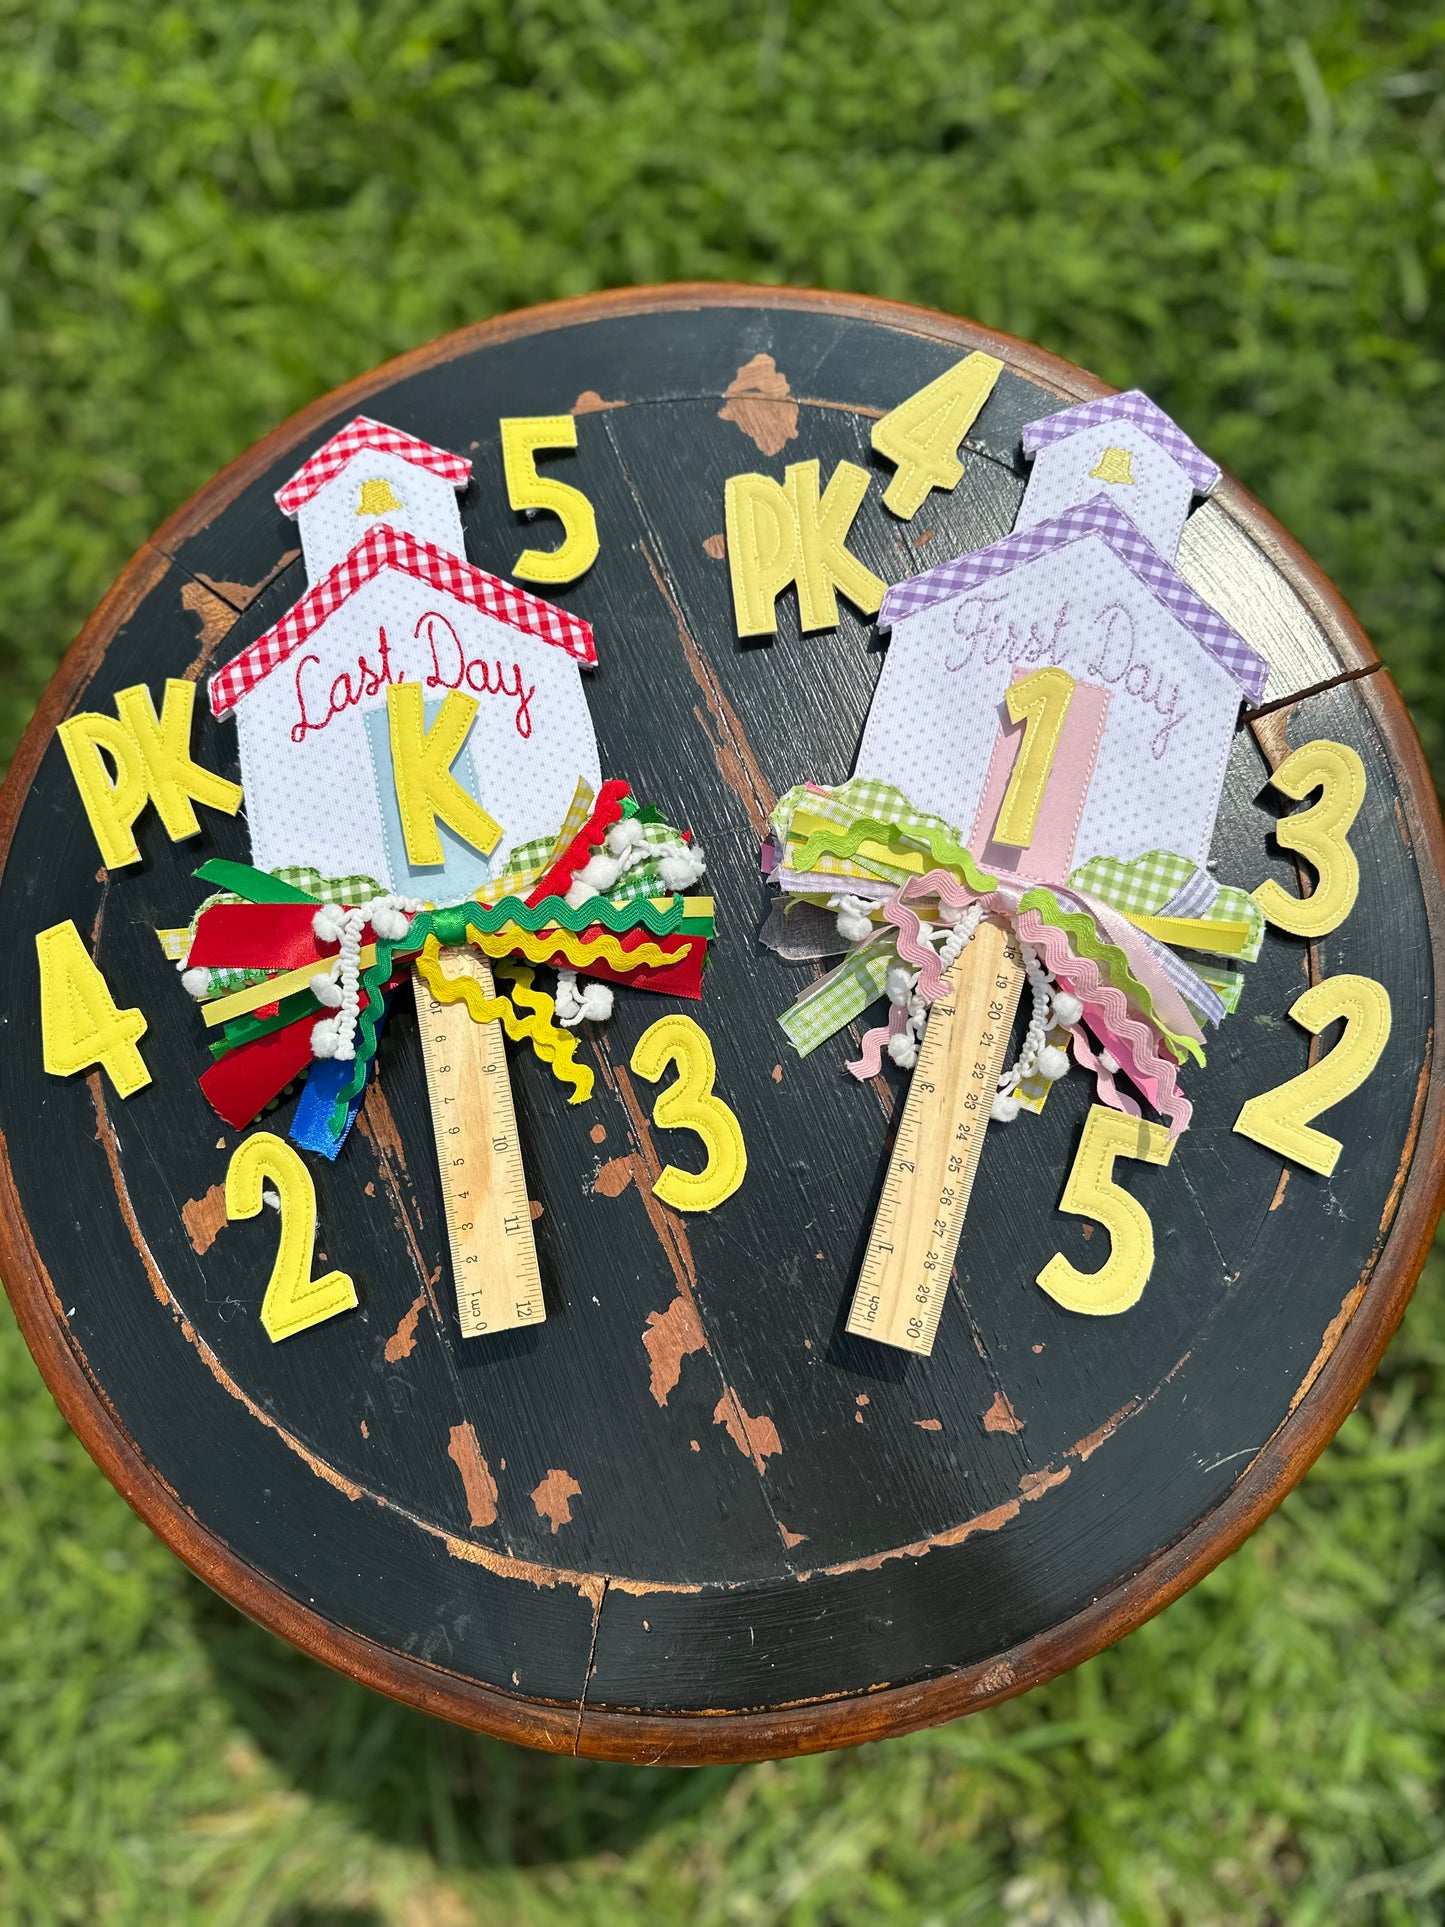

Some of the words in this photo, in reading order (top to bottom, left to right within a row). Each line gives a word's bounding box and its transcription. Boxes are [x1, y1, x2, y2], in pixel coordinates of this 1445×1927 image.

[871, 351, 1005, 521] 4
[500, 414, 600, 584] 5
[724, 459, 890, 638] PK
[291, 626, 406, 743] Last
[414, 611, 535, 739] Day
[944, 594, 1067, 672] First
[1088, 602, 1185, 759] Day
[992, 666, 1077, 850] 1
[58, 678, 244, 870] PK
[386, 681, 504, 867] K
[1253, 739, 1367, 938] 3
[1003, 946, 1016, 960] 18
[995, 974, 1009, 988] 19
[35, 919, 153, 1099] 4
[430, 1001, 443, 1015] 10
[941, 1007, 956, 1016] 4
[987, 1002, 1004, 1020] 20
[435, 1035, 447, 1043] 9
[979, 1031, 994, 1048] 21
[440, 1065, 451, 1073] 8
[972, 1062, 986, 1080] 22
[1232, 974, 1393, 1177] 2
[920, 1084, 935, 1094] 3
[444, 1097, 455, 1105] 7
[964, 1093, 979, 1110] 23
[630, 1014, 748, 1213] 3
[449, 1126, 460, 1134] 6
[956, 1125, 971, 1141] 24
[492, 1136, 509, 1152] 10
[453, 1158, 465, 1166] 5
[899, 1163, 914, 1174] 2
[948, 1154, 963, 1174] 25
[458, 1190, 470, 1199] 4
[940, 1188, 955, 1206] 26
[1036, 1103, 1178, 1316] 5
[462, 1222, 474, 1230] 3
[504, 1216, 520, 1234] 11
[932, 1221, 947, 1239] 27
[225, 1131, 359, 1344] 2
[878, 1244, 895, 1254] 1
[466, 1255, 478, 1263] 2
[923, 1251, 939, 1271] 28
[915, 1285, 931, 1304] 29
[472, 1298, 481, 1317] cm
[516, 1301, 533, 1318] 12
[863, 1296, 880, 1323] inch
[476, 1322, 488, 1331] 0
[906, 1318, 923, 1339] 30
